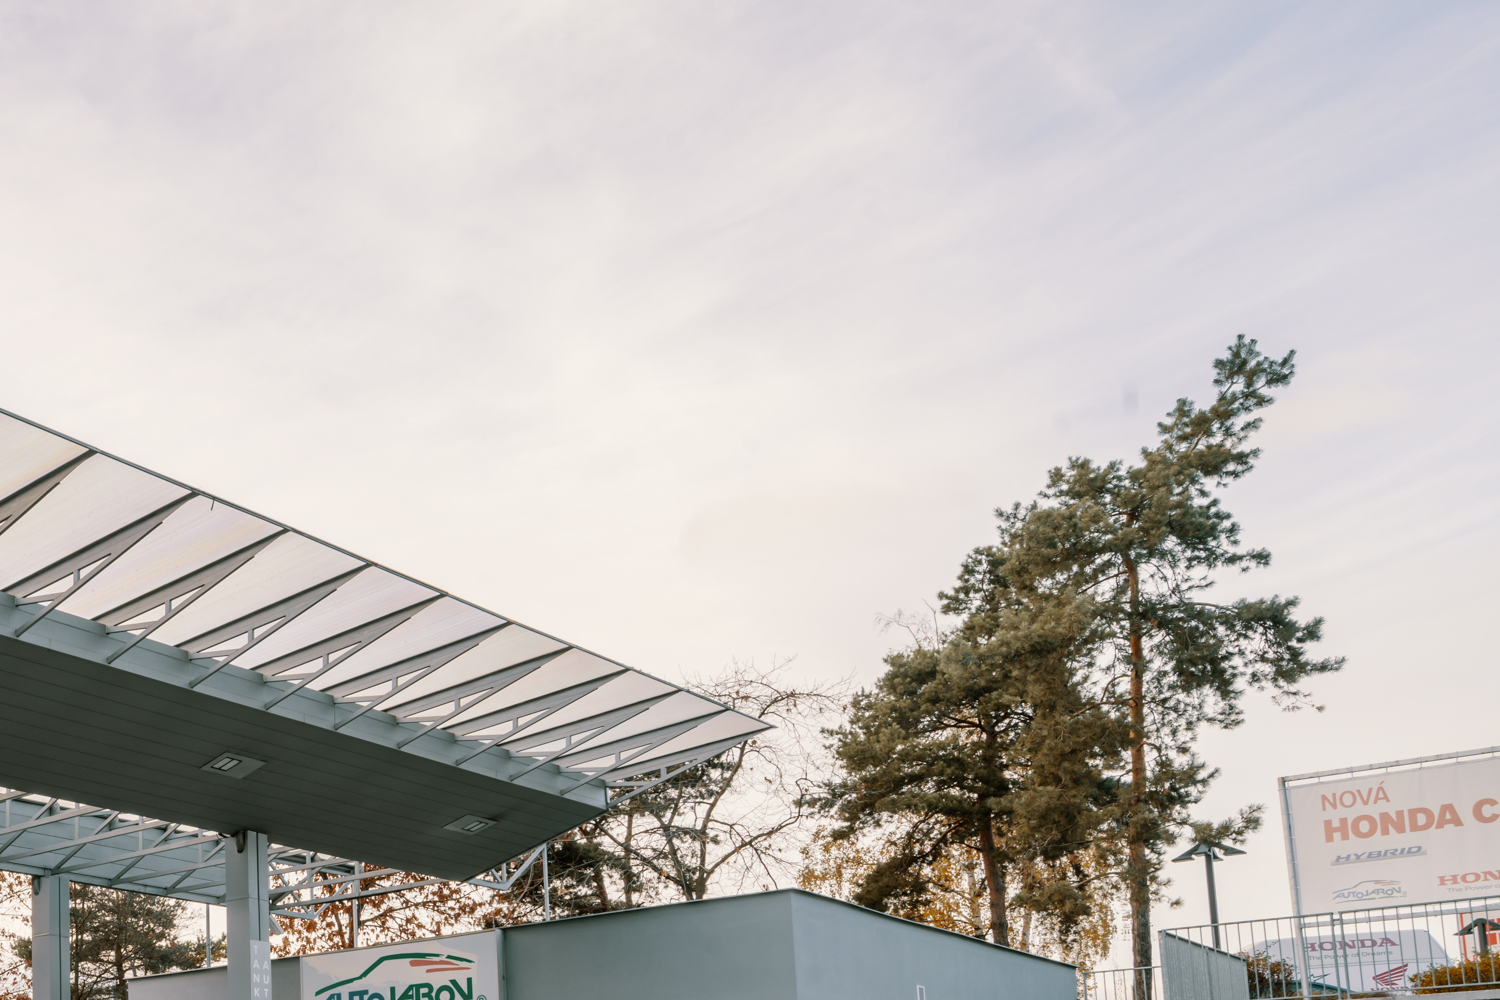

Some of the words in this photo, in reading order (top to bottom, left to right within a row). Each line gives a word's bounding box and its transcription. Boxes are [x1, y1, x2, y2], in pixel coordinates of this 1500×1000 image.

[1320, 780, 1391, 812] NOVÁ
[1323, 803, 1464, 843] HONDA
[1334, 845, 1423, 863] HYBRID
[1464, 883, 1492, 892] Power
[1301, 937, 1399, 953] HONDA
